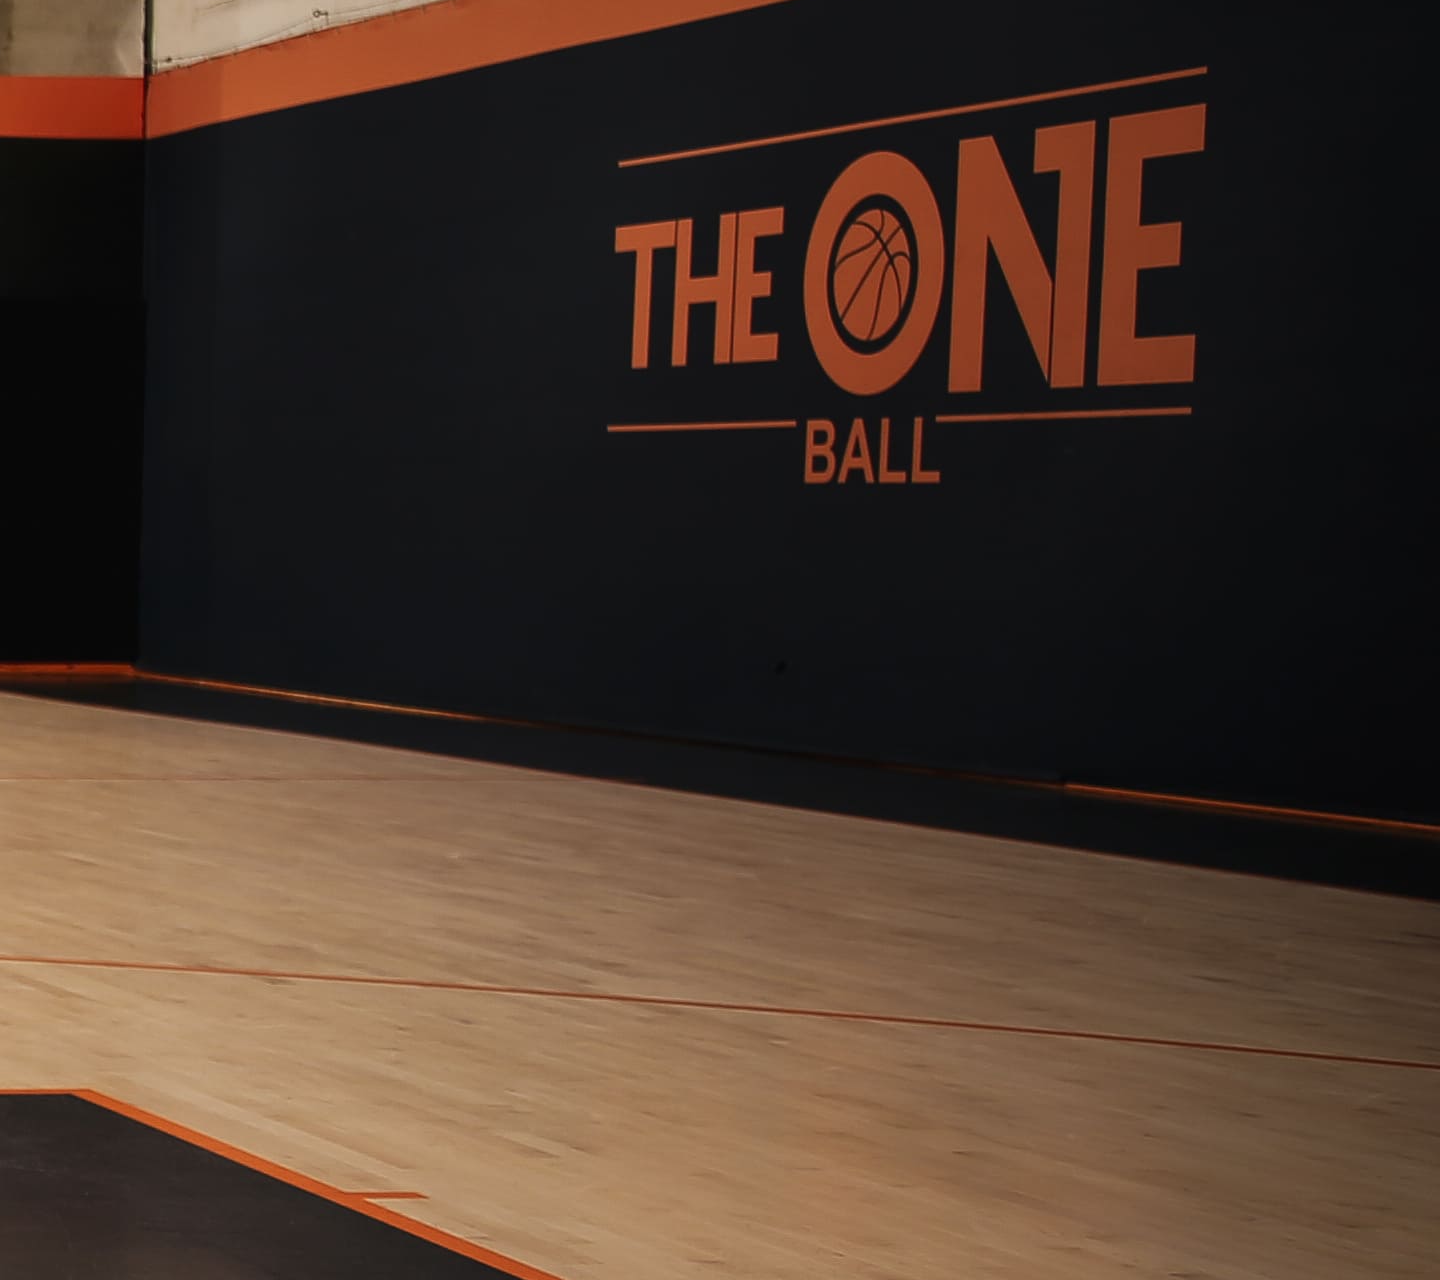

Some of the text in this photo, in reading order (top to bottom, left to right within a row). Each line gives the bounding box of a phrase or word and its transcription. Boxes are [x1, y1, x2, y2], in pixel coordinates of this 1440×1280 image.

[613, 101, 1208, 397] THE ONE
[802, 416, 941, 485] BALL
